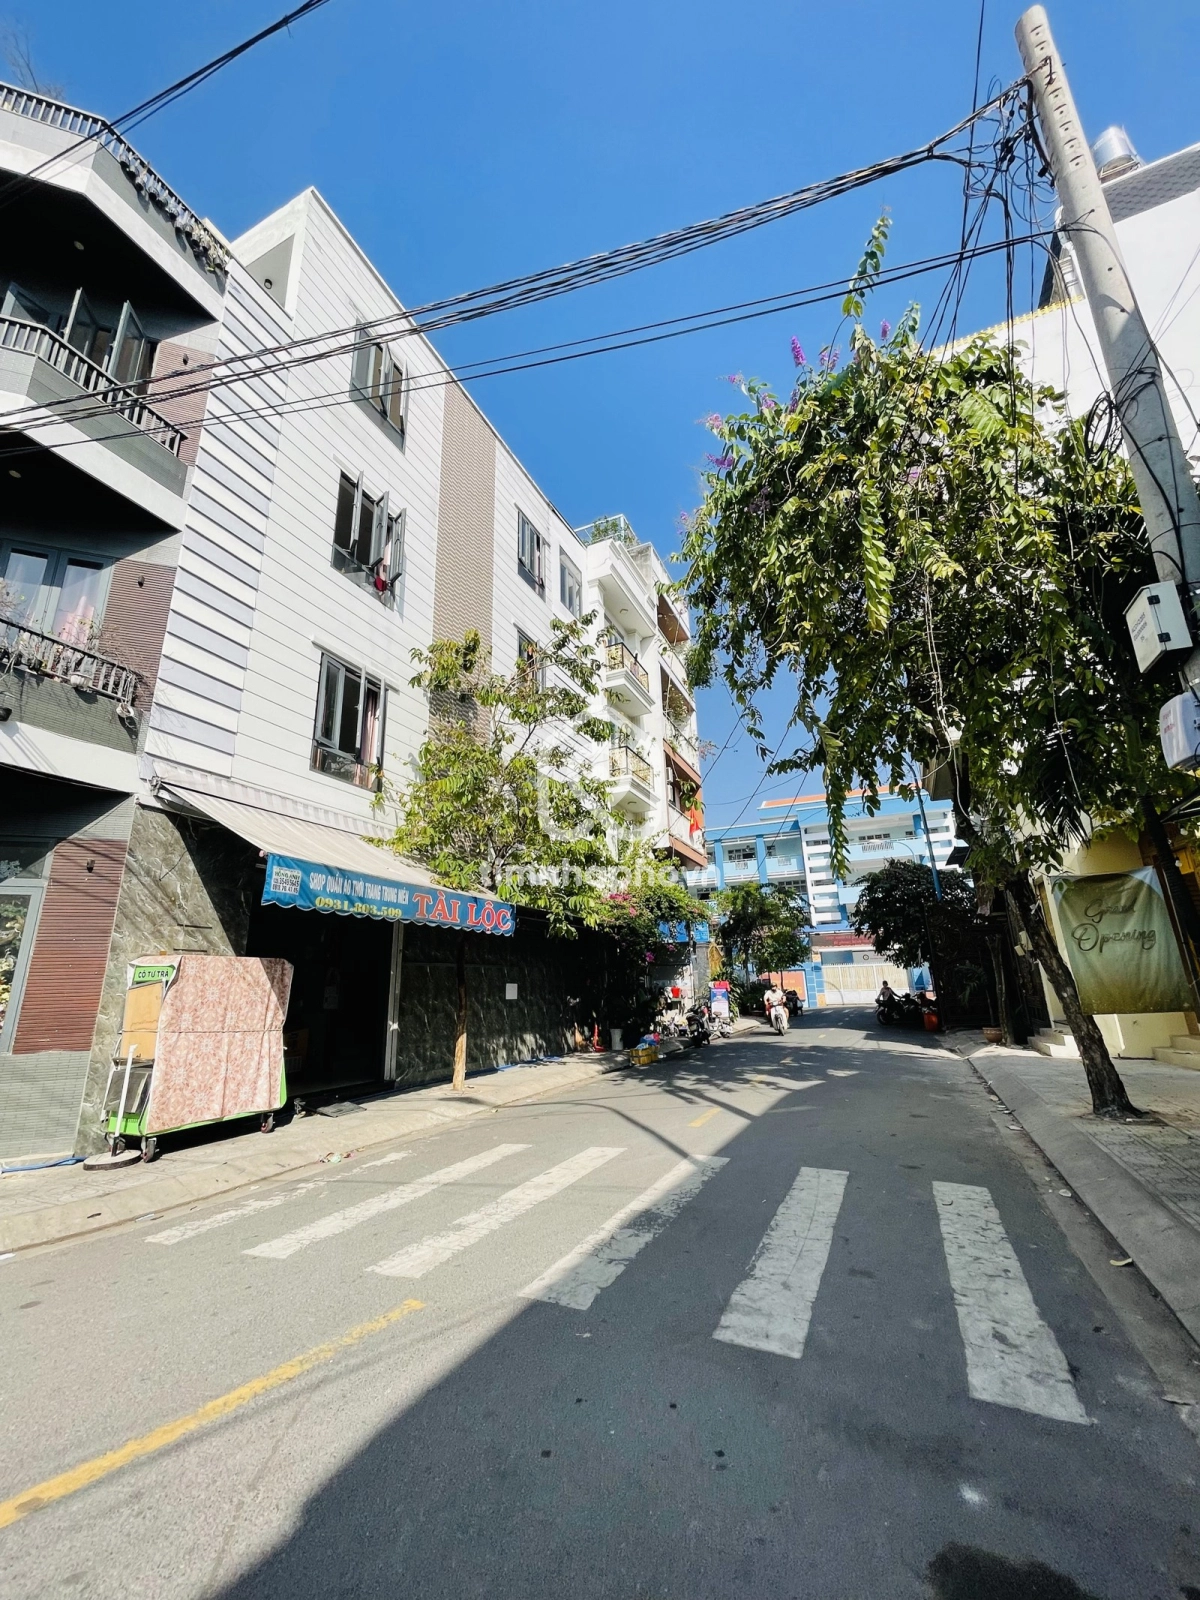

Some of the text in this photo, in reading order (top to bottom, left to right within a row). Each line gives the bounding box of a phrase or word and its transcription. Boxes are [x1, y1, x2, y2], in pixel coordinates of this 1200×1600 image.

[309, 872, 326, 891] SHOP
[343, 875, 352, 896] ÁO
[364, 882, 381, 901] TRANG
[381, 885, 398, 903] TRUNG
[412, 890, 512, 934] TÀI LỘC
[1071, 922, 1157, 953] Opening
